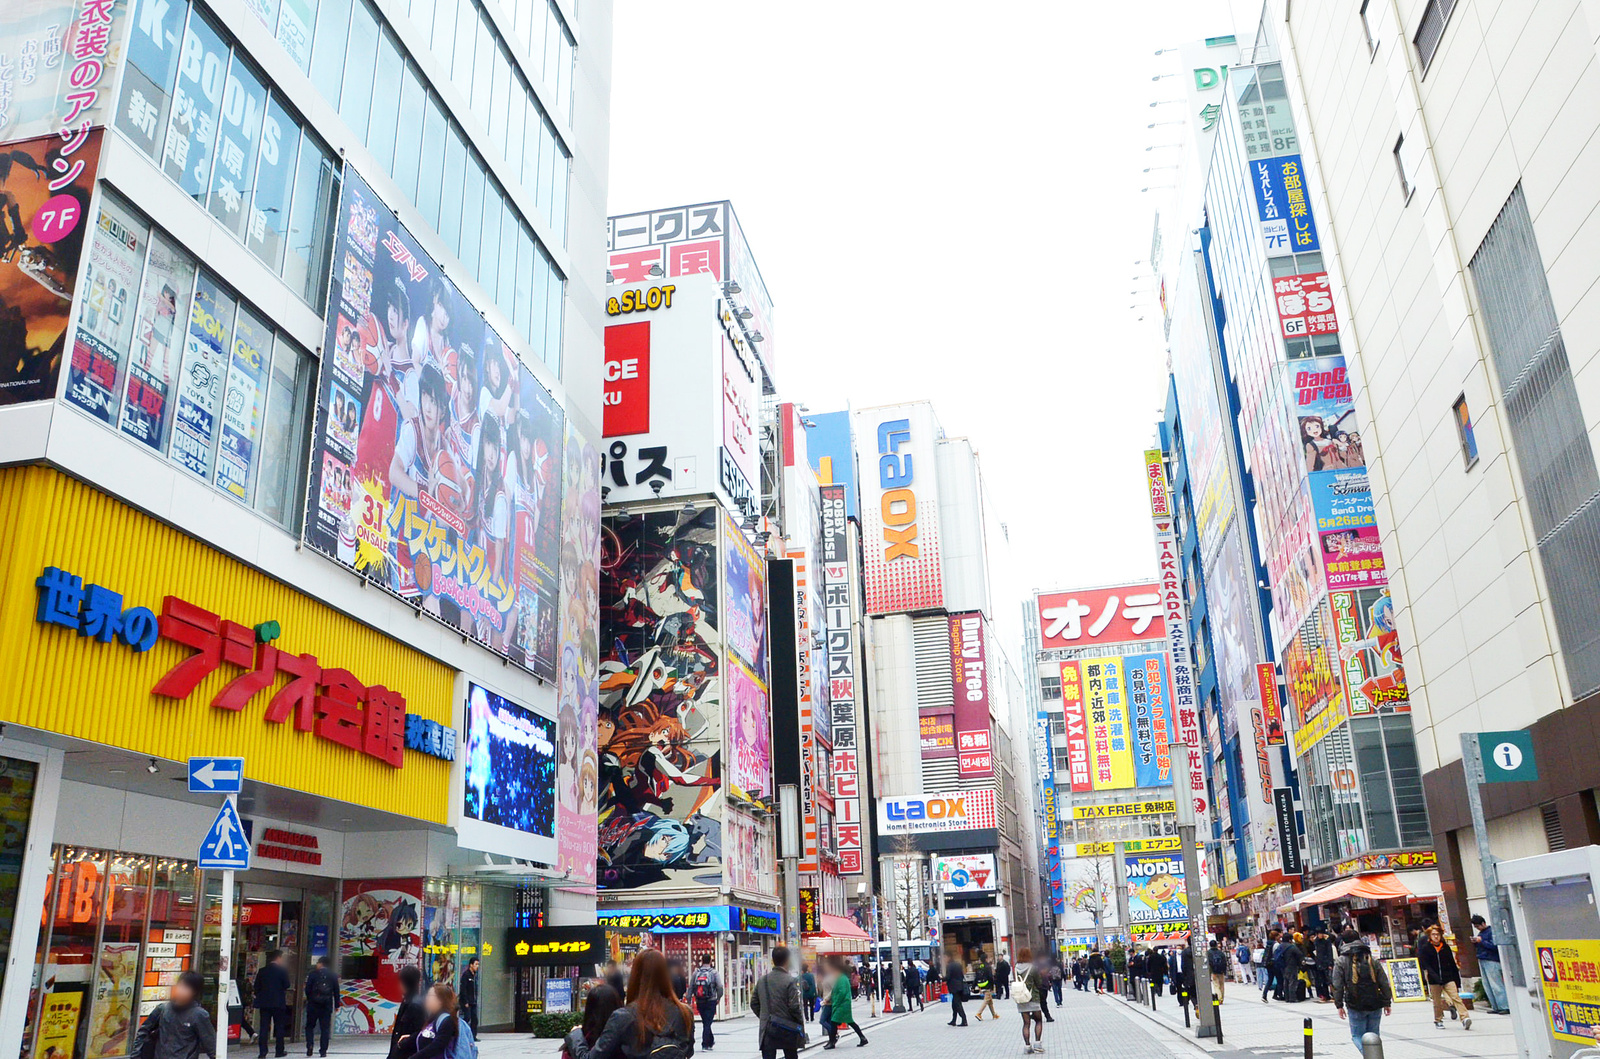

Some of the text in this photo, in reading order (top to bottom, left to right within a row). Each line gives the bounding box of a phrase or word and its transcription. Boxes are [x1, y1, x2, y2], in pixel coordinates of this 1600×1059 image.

[138, 0, 283, 166] K-BOOKS
[1240, 105, 1277, 118] 不動産
[1244, 131, 1268, 142] 売買
[1271, 128, 1293, 136] 当ビル
[1273, 136, 1296, 150] 8F
[1248, 143, 1272, 154] 管理
[1257, 162, 1279, 218] レオパレス21
[1281, 161, 1313, 245] お部屋探しは
[41, 207, 75, 231] 7F
[606, 206, 723, 249] ークス
[1264, 225, 1286, 233] 当ビル
[1265, 234, 1287, 248] 7F
[608, 285, 676, 315] & SLOT
[1285, 320, 1303, 332] 6F
[1308, 314, 1336, 324] 秋葉原
[1309, 322, 1337, 332] 2号店
[1295, 367, 1345, 389] BanG
[185, 386, 206, 405] TOYS
[1148, 463, 1167, 513] まんが喫茶
[362, 494, 384, 532] 3.1
[823, 489, 835, 560] PARADISE
[833, 489, 844, 535] HOBBY
[1331, 506, 1355, 515] BanG
[357, 525, 388, 554] ON SALE
[1158, 541, 1182, 620] TAKARADA
[1329, 570, 1369, 583] 2017年春
[36, 566, 158, 652] 世界の
[953, 619, 963, 683] Flagship Store
[961, 617, 984, 702] Duty Free
[151, 595, 406, 769] ラジオ会館
[1174, 665, 1194, 706] 免税商店
[921, 716, 936, 725] 本店
[1103, 663, 1125, 751] 冷蔵庫 洗濯機
[1131, 669, 1153, 765] お見積り無料です
[1146, 659, 1171, 780] 防犯カメラ販売開始!!
[404, 713, 457, 761] 秋葉原
[961, 733, 988, 747] 免税
[1062, 666, 1089, 785] 免税 TAX FREE
[962, 756, 990, 769] 면세점
[1036, 718, 1050, 780] Panasonic
[1250, 707, 1273, 805] GAMERS
[1045, 787, 1058, 839] ONODEN
[1079, 801, 1175, 818] TAX FREE 免税店
[1283, 813, 1291, 832] STORE
[263, 828, 319, 849] AKIHABARA
[886, 819, 968, 831] Home Electronics Store
[256, 844, 322, 866] RADIOKAIKAN
[1083, 843, 1110, 854] テレビ
[1146, 838, 1181, 849] エアコン
[1286, 834, 1295, 868] ALIENWARE
[1049, 845, 1063, 907] オノデン
